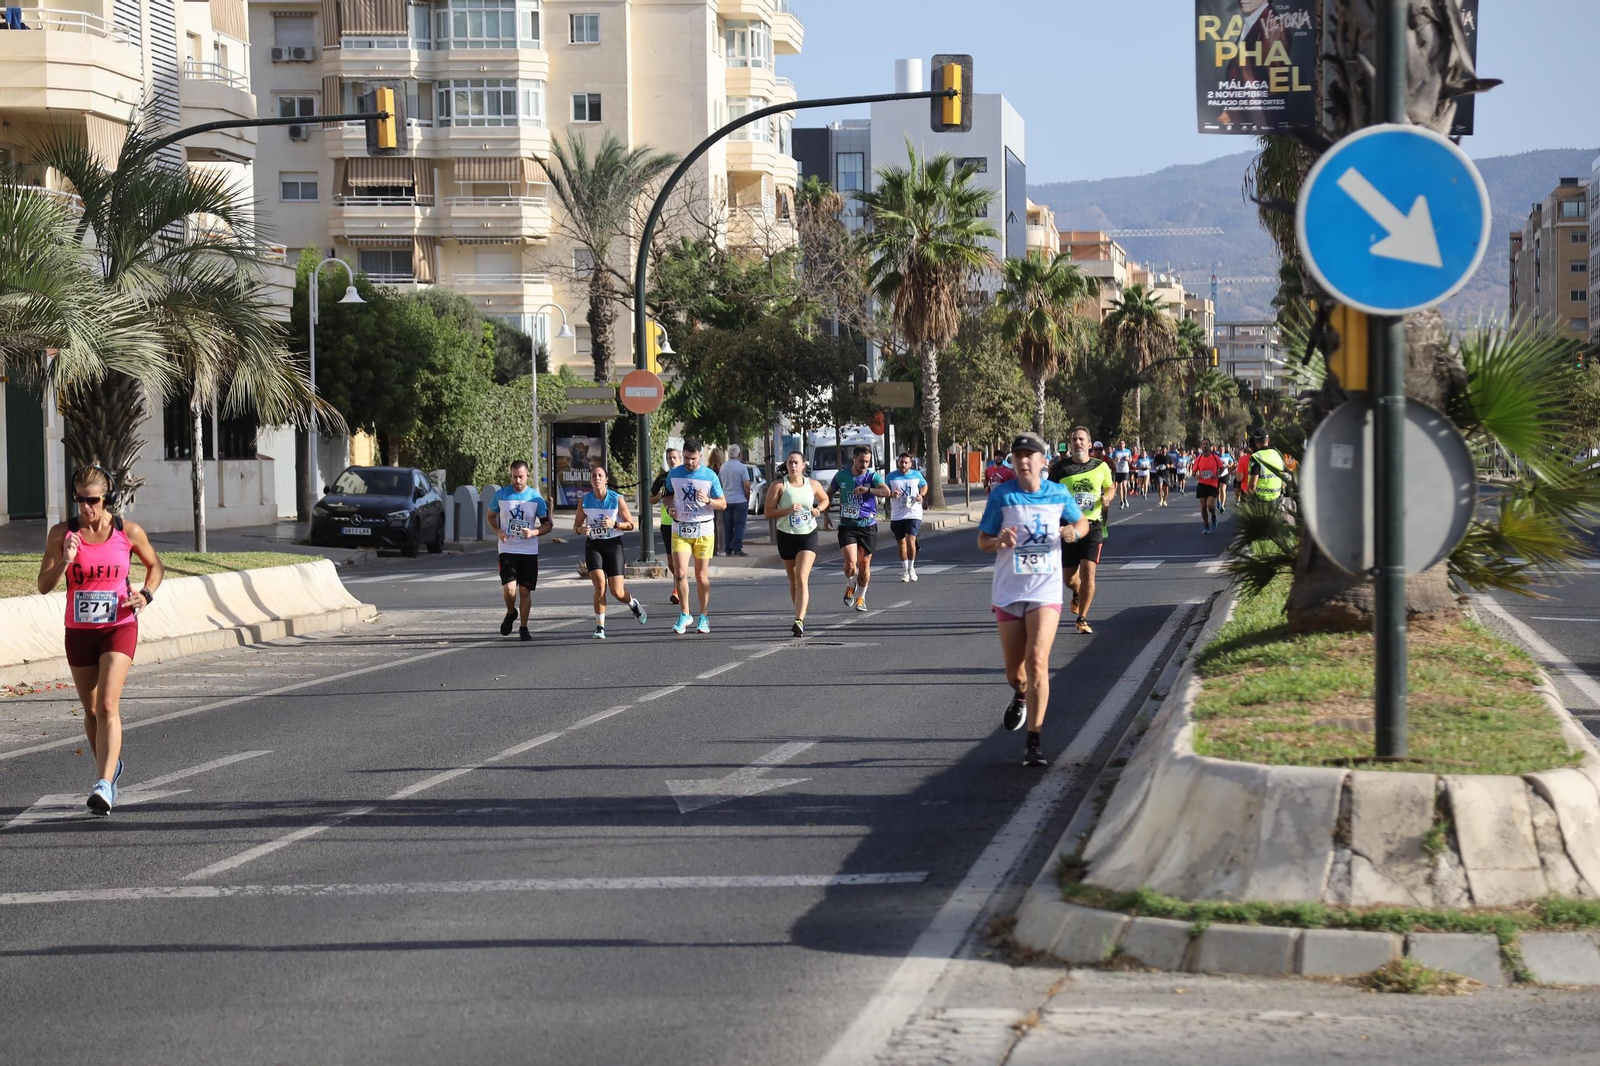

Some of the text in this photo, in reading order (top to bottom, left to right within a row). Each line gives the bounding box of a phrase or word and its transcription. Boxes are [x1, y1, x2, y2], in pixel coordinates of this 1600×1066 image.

[1198, 14, 1244, 41] RA
[1215, 40, 1292, 67] PHA
[1218, 79, 1269, 90] MÁLAGA
[1269, 66, 1312, 92] EL
[1207, 90, 1269, 99] 2 NOVIEMBRE
[563, 471, 582, 482] TULSA
[592, 527, 607, 535] 101
[1020, 553, 1046, 565] 731
[79, 601, 110, 613] 271
